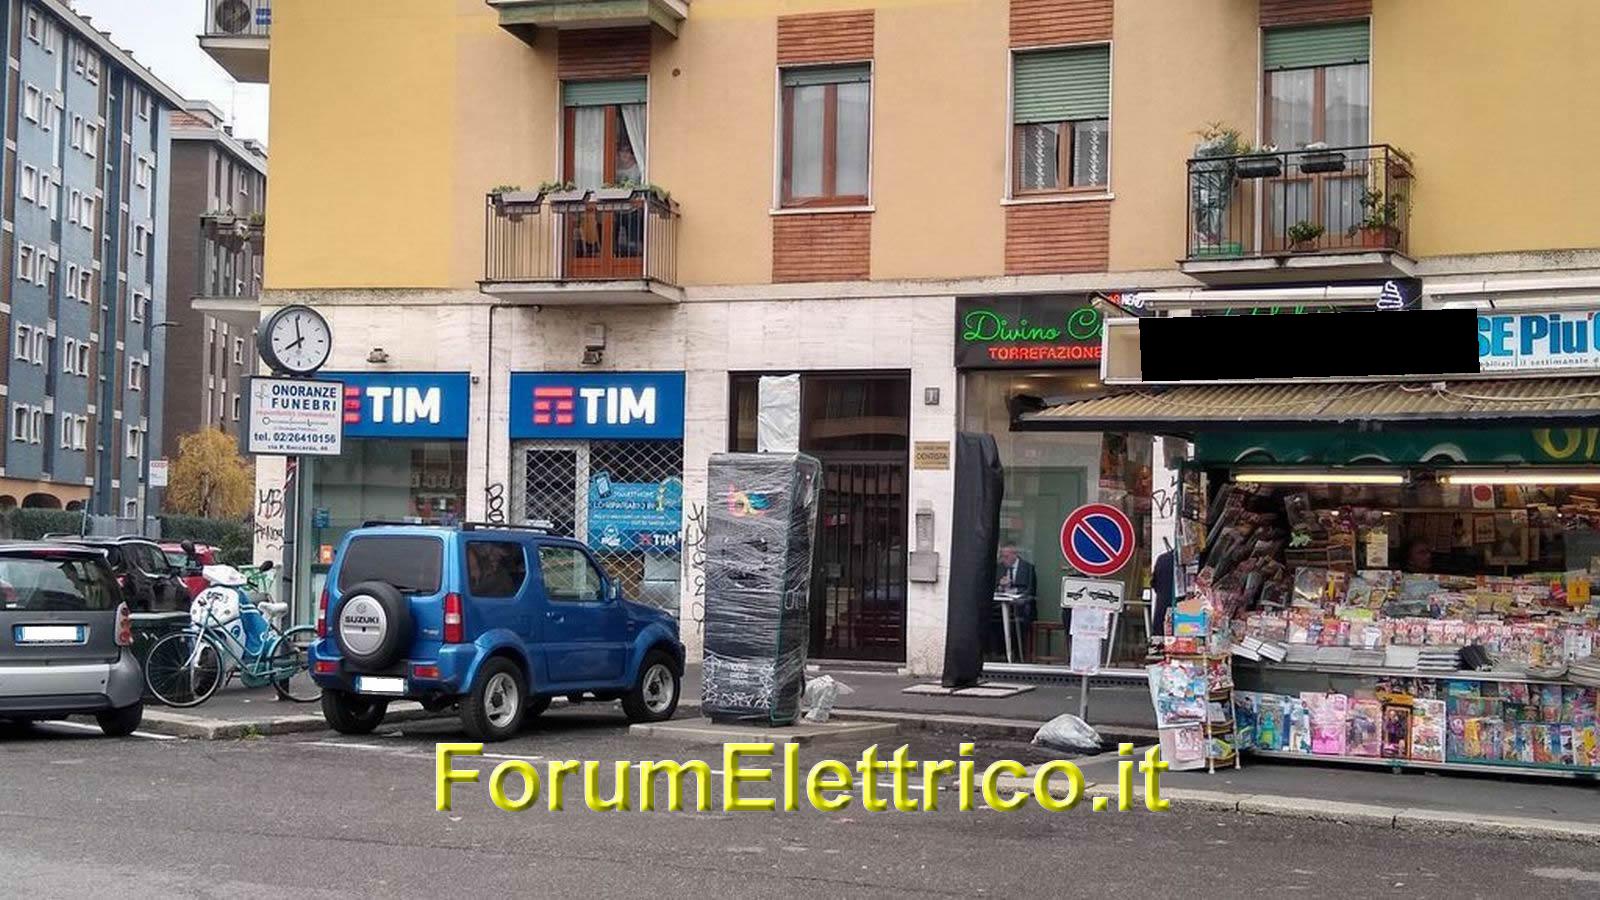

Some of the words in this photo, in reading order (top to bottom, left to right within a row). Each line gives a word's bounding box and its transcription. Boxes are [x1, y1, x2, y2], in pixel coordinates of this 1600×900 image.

[963, 308, 1061, 342] Divino
[988, 345, 1102, 361] TORREFAZIONE
[271, 384, 337, 399] ONORANZE
[271, 397, 337, 412] FUNEBRI
[366, 386, 441, 424] TIM
[579, 387, 656, 425] TIM
[254, 432, 271, 441] tel.
[272, 432, 337, 444] 02/26410156
[652, 533, 677, 546] TIM
[344, 616, 380, 625] SUZUKI
